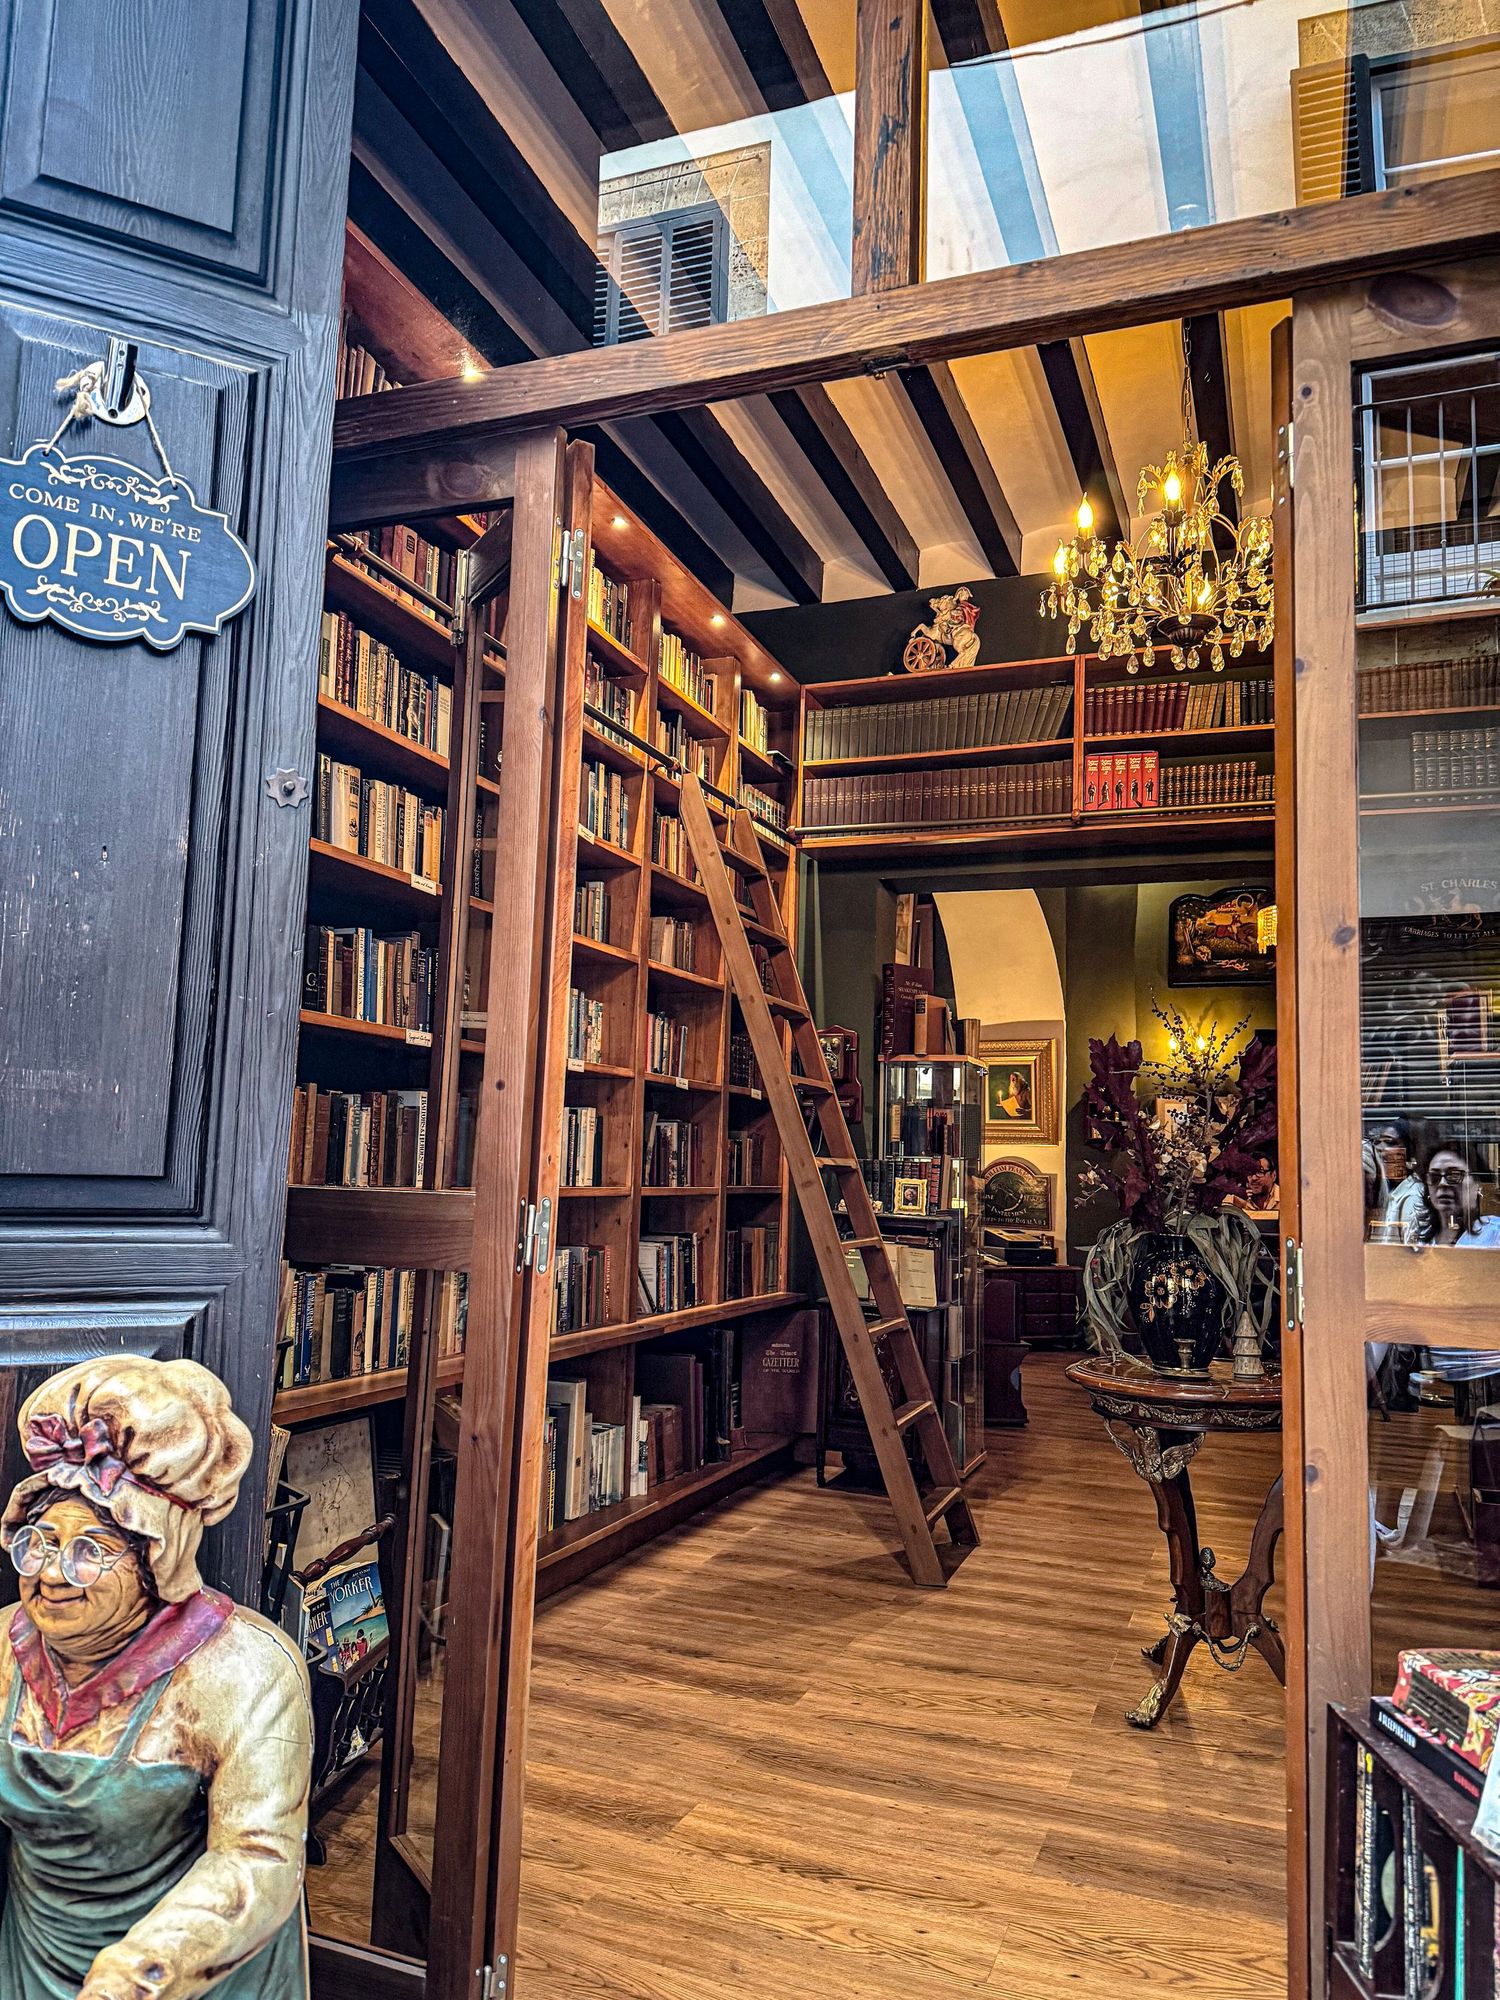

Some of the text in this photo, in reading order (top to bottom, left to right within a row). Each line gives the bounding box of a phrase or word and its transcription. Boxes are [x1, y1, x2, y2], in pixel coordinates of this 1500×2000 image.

[8, 483, 202, 543] COME IN, WE'RE
[12, 513, 192, 601] OPEN
[1441, 878, 1498, 890] CHARLES
[762, 1357, 800, 1368] GAZETTEER
[330, 1579, 341, 1590] THE
[330, 1576, 374, 1605] YORKER
